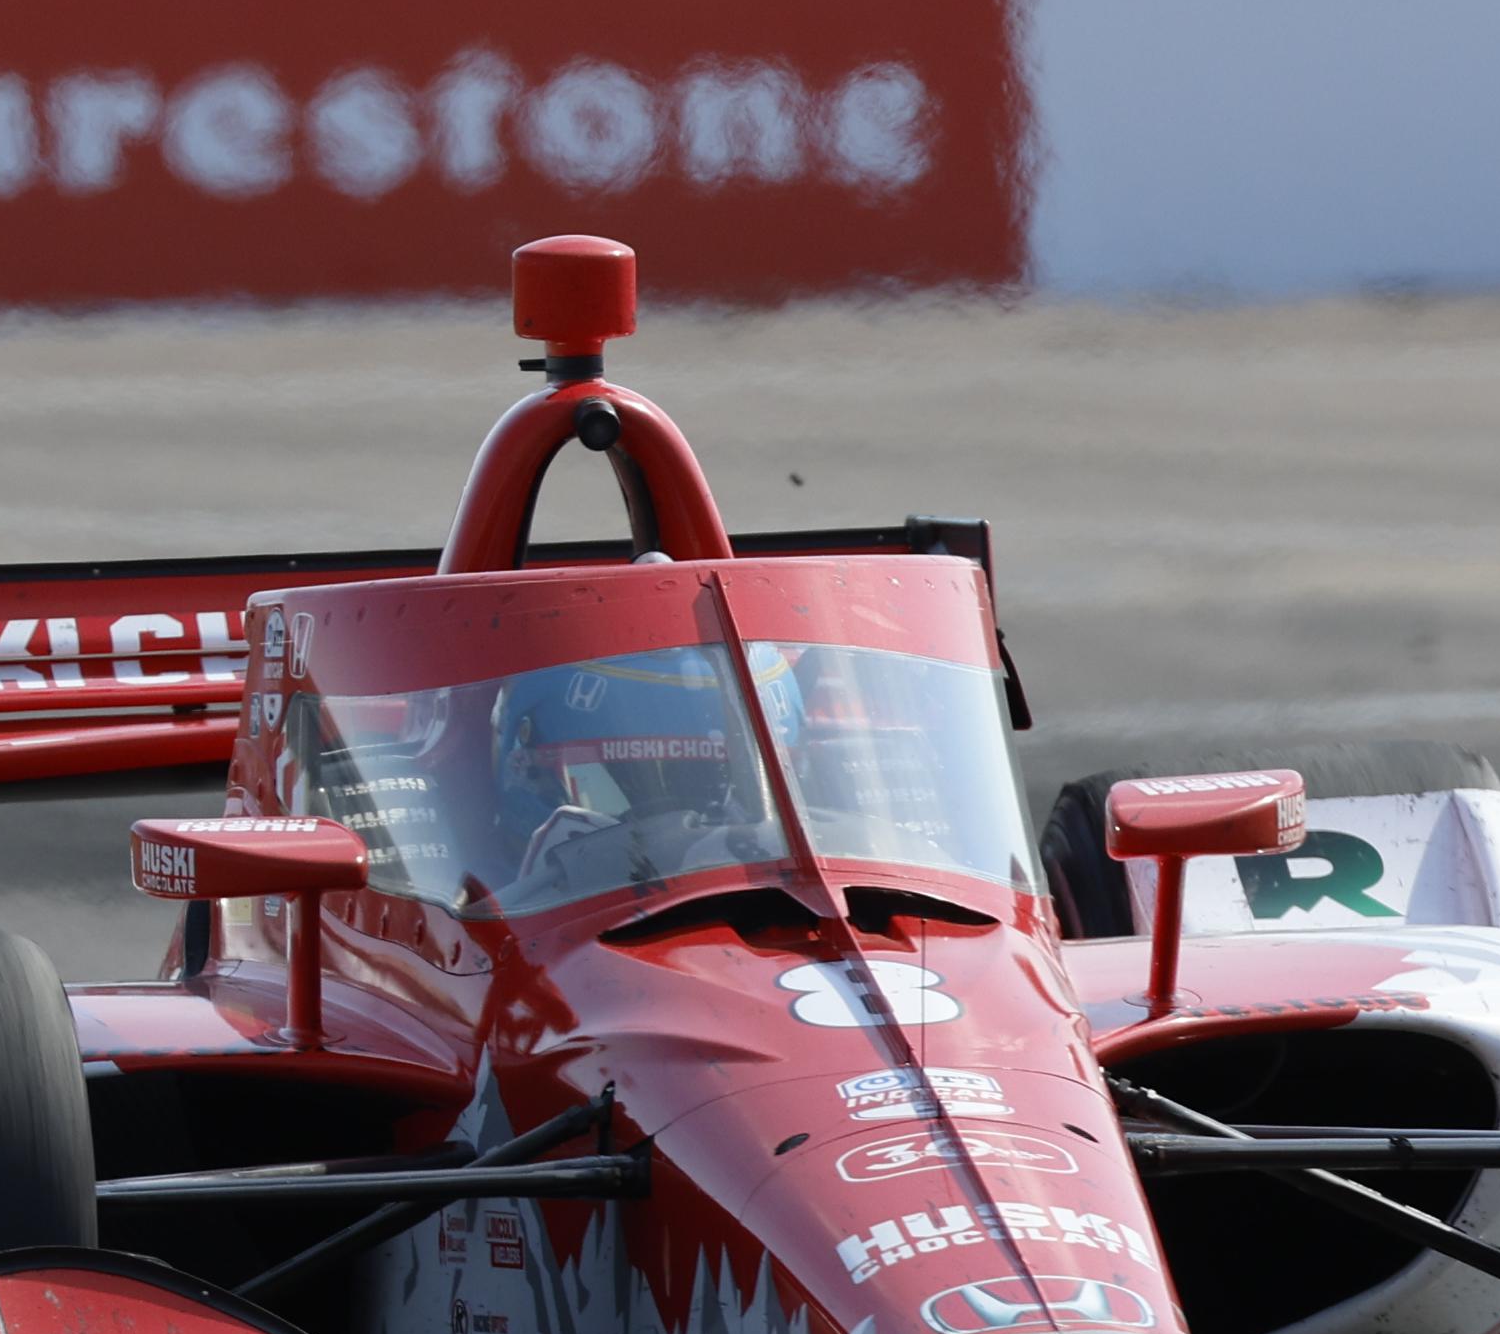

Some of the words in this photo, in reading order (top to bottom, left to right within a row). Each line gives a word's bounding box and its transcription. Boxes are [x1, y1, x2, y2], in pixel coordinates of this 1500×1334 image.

[603, 741, 665, 760] HUSKI
[141, 841, 196, 876] HUSKI
[141, 873, 196, 895] CHOCOLATE
[774, 959, 966, 1028] 8
[836, 1201, 1158, 1274] HUSKI
[850, 1227, 1158, 1285] CHOCOLATE
